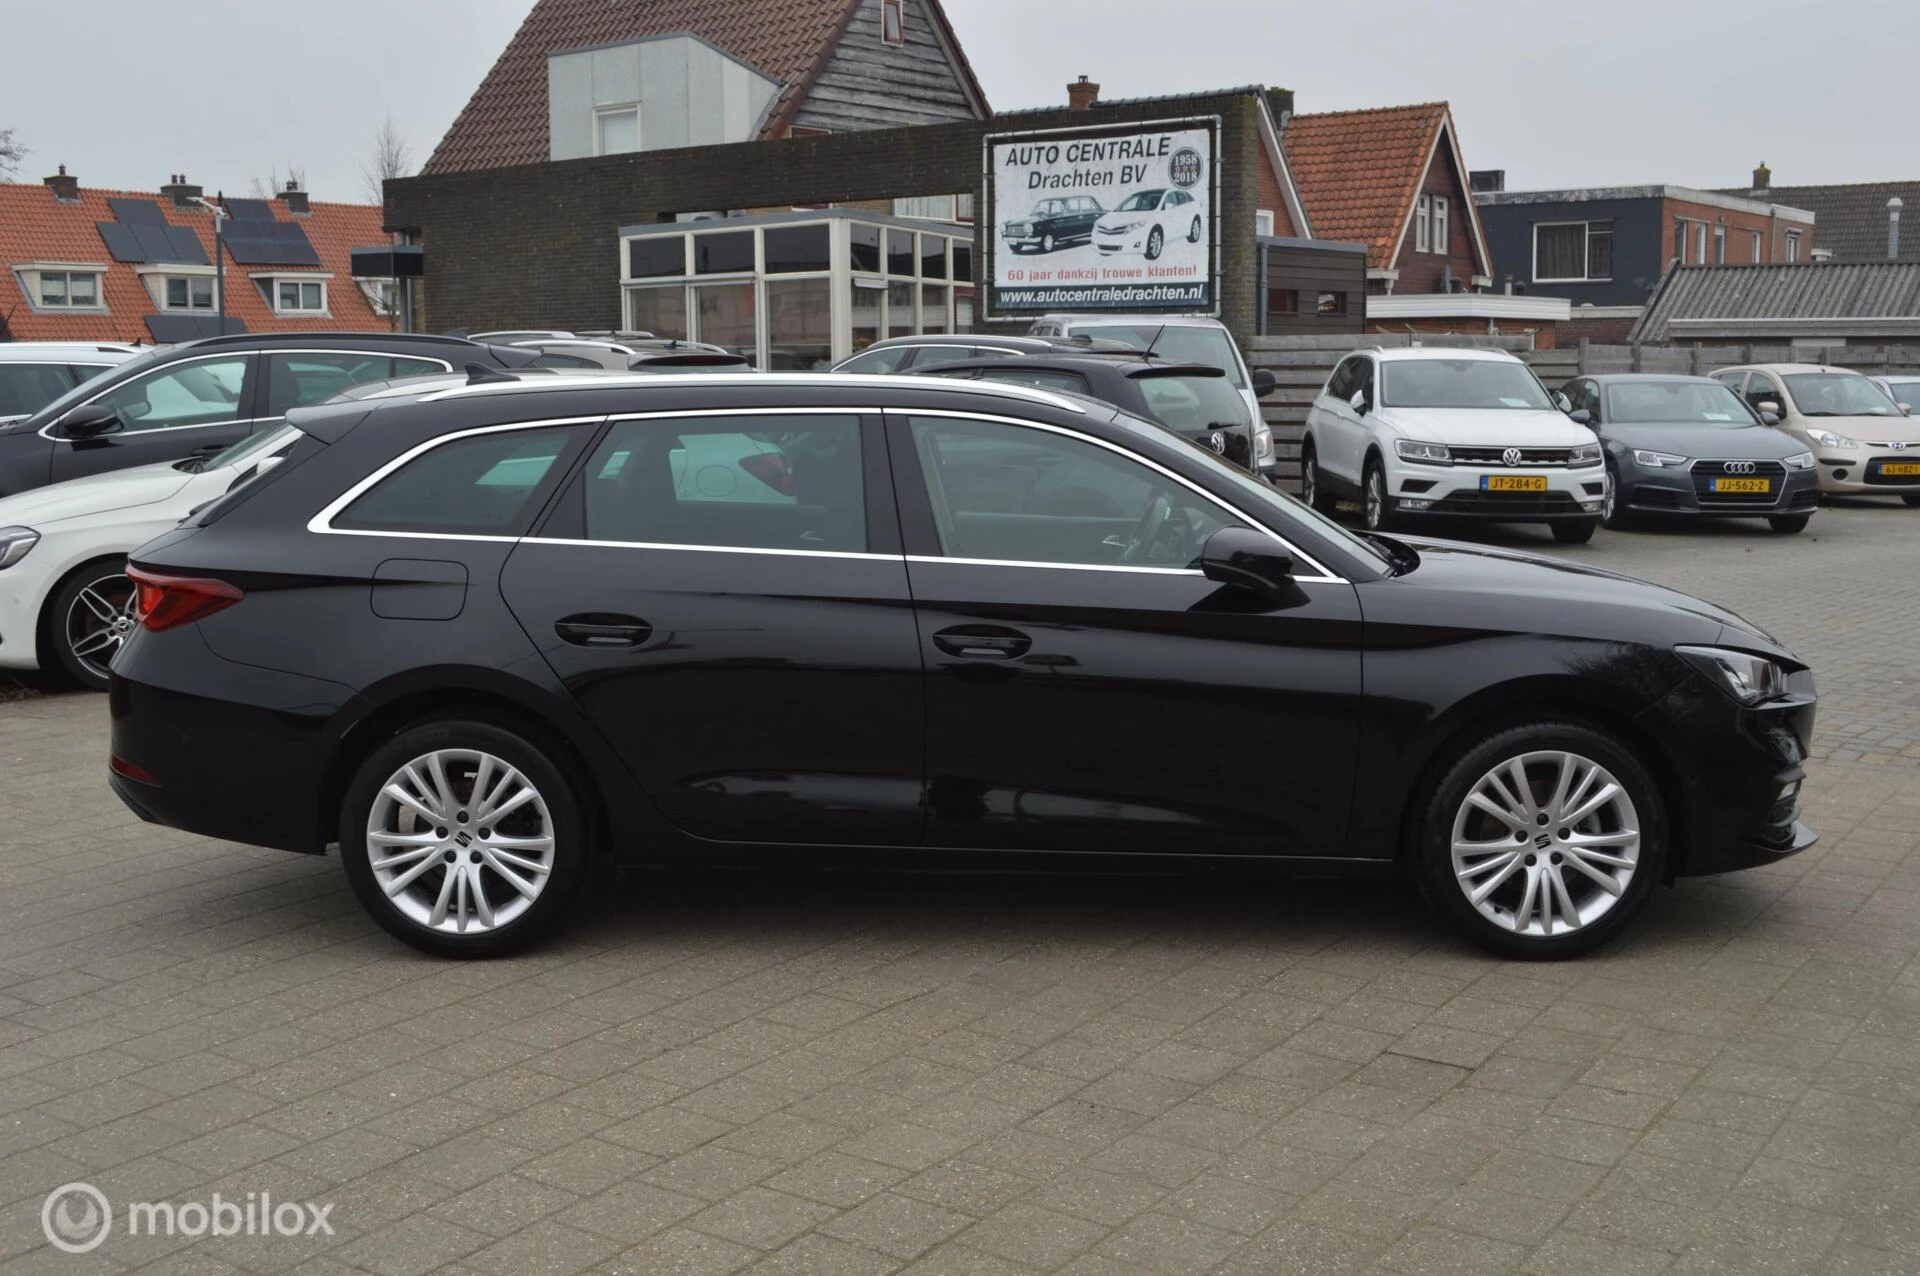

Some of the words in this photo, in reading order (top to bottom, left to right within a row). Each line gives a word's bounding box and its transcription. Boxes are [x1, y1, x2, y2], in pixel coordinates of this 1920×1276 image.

[1005, 145, 1060, 167] AUTO
[1066, 136, 1171, 163] CENTRALE
[1174, 154, 1197, 166] 1958
[1028, 168, 1113, 190] Drachten
[1120, 164, 1147, 185] BV
[1174, 171, 1198, 183] 2018
[1007, 269, 1024, 281] 60
[1028, 269, 1051, 282] jaar
[1057, 267, 1097, 281] dankzij
[1103, 267, 1142, 279] trouwe
[1147, 265, 1197, 277] klanten!
[1000, 284, 1203, 303] www.autocentraledrachten.nl
[1492, 478, 1542, 489] JT-284-G
[1720, 480, 1764, 490] JJ-562-Z
